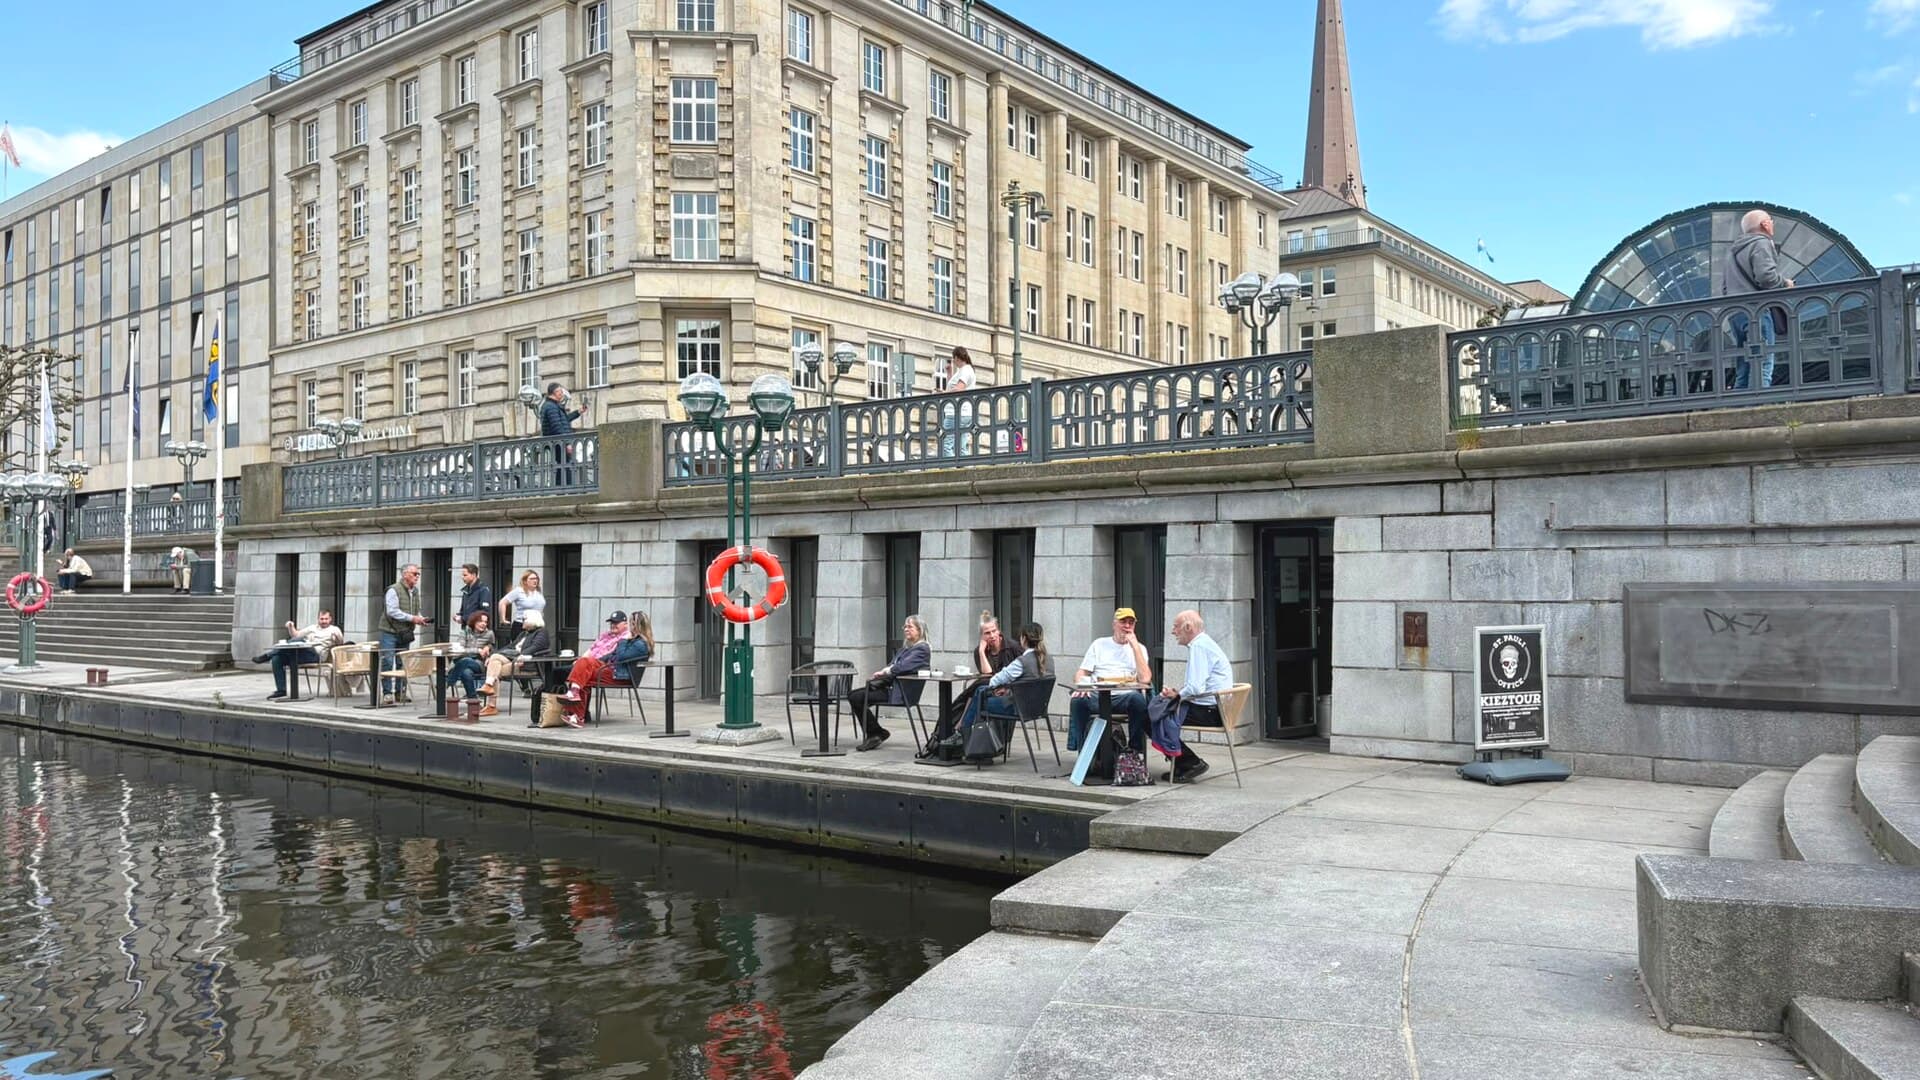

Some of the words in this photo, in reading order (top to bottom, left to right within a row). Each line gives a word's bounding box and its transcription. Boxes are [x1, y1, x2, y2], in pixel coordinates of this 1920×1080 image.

[382, 424, 412, 438] CHINA
[1492, 637, 1504, 649] ST.
[1503, 634, 1527, 648] PAULI
[1497, 677, 1525, 689] OFFICE
[1480, 693, 1542, 707] KIEZTOUR
